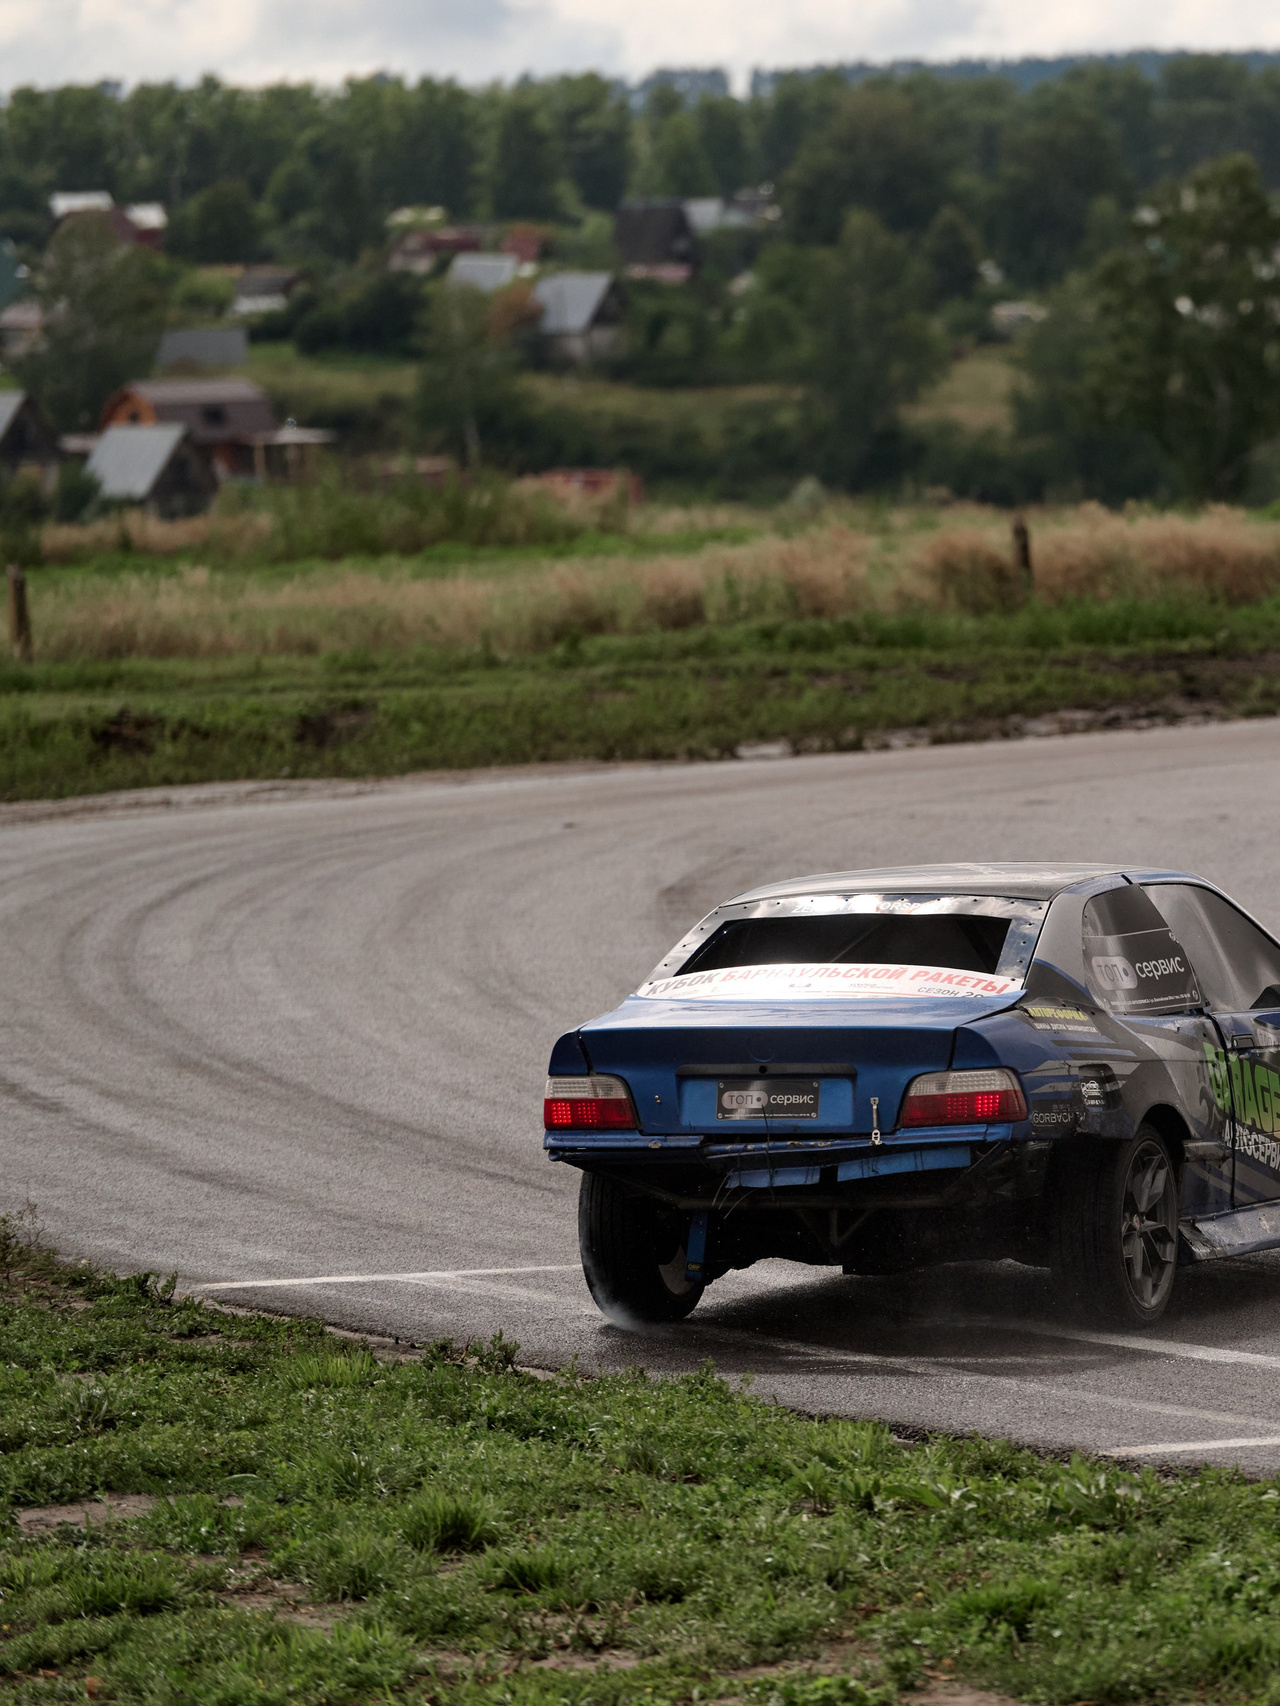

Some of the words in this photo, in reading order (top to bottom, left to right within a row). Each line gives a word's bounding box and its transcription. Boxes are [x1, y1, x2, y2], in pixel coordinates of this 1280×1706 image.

[1096, 964, 1124, 982] ТОП
[1135, 957, 1185, 980] сервис
[645, 972, 721, 997] КУБОК
[720, 966, 909, 983] БАРНАУЛЬСКОЙ
[909, 970, 1010, 995] РАКЕТЫ
[917, 986, 959, 997] СЕЗОН
[728, 1094, 753, 1105] ТОП
[770, 1094, 815, 1106] сервис
